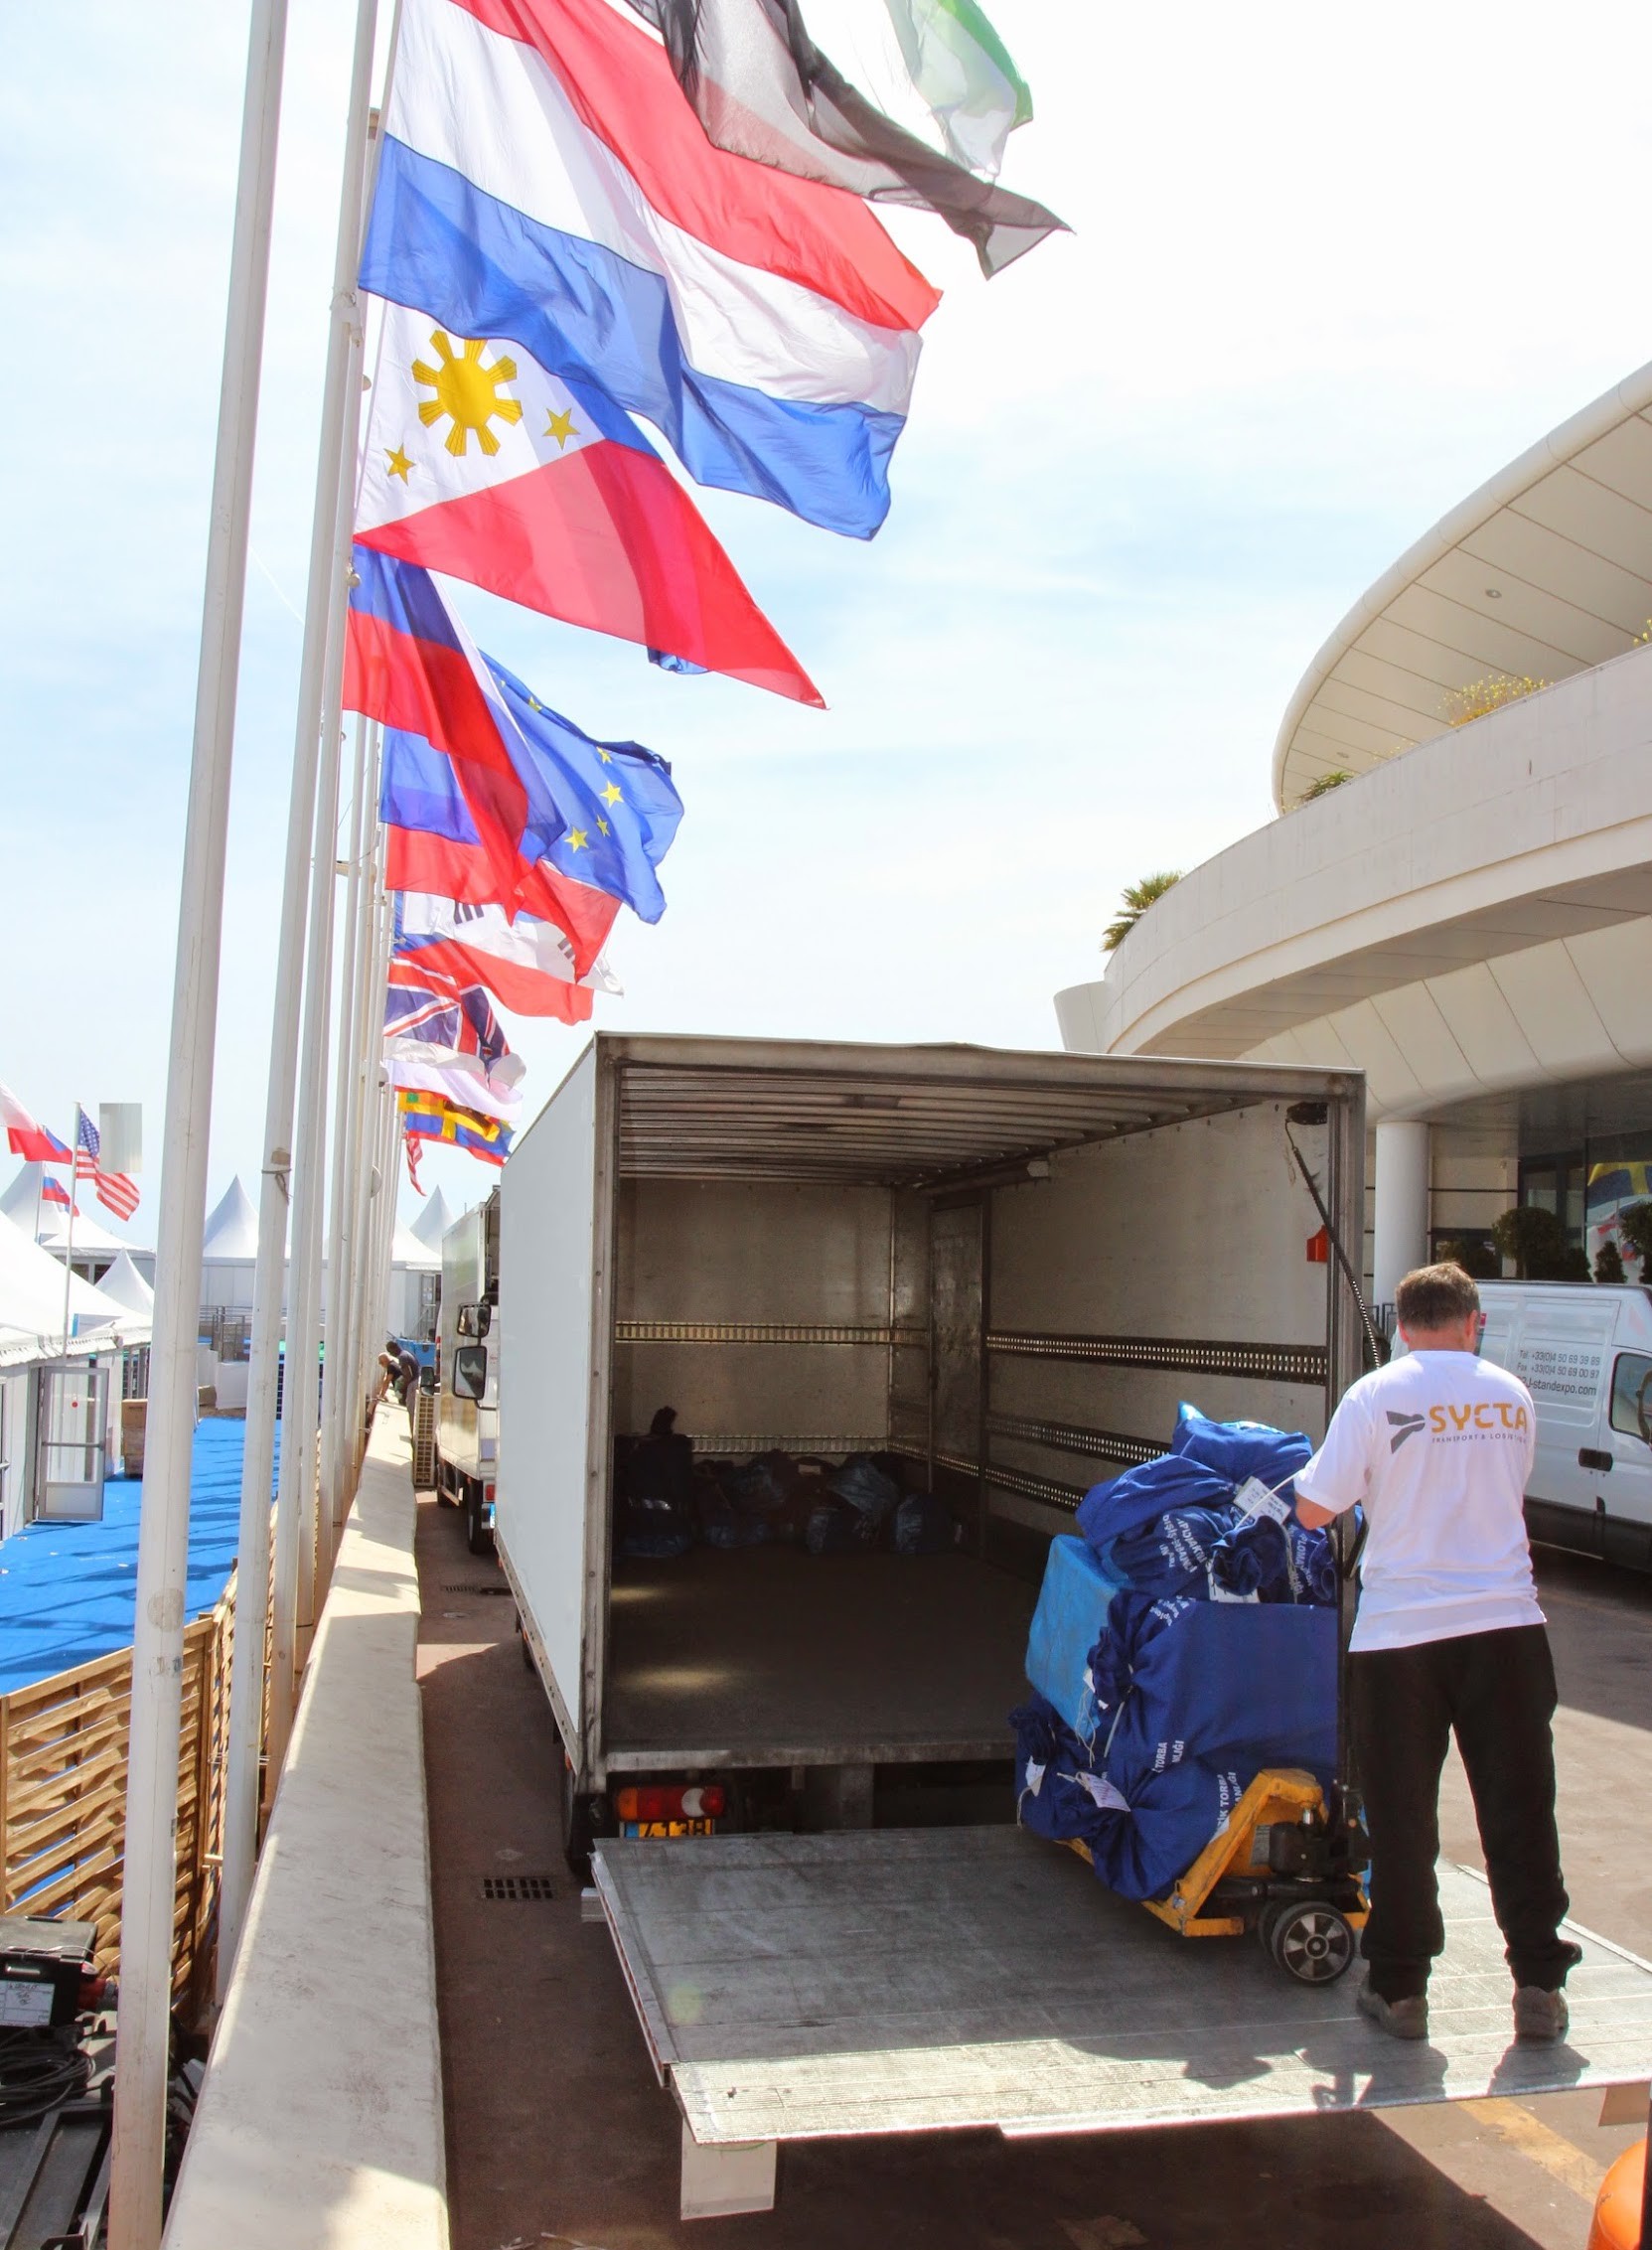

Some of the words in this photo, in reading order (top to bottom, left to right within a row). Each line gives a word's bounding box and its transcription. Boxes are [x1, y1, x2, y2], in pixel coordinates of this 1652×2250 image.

[1558, 1353, 1567, 1363] 50
[1557, 1366, 1567, 1376] 50
[1429, 1403, 1527, 1433] SYCTA
